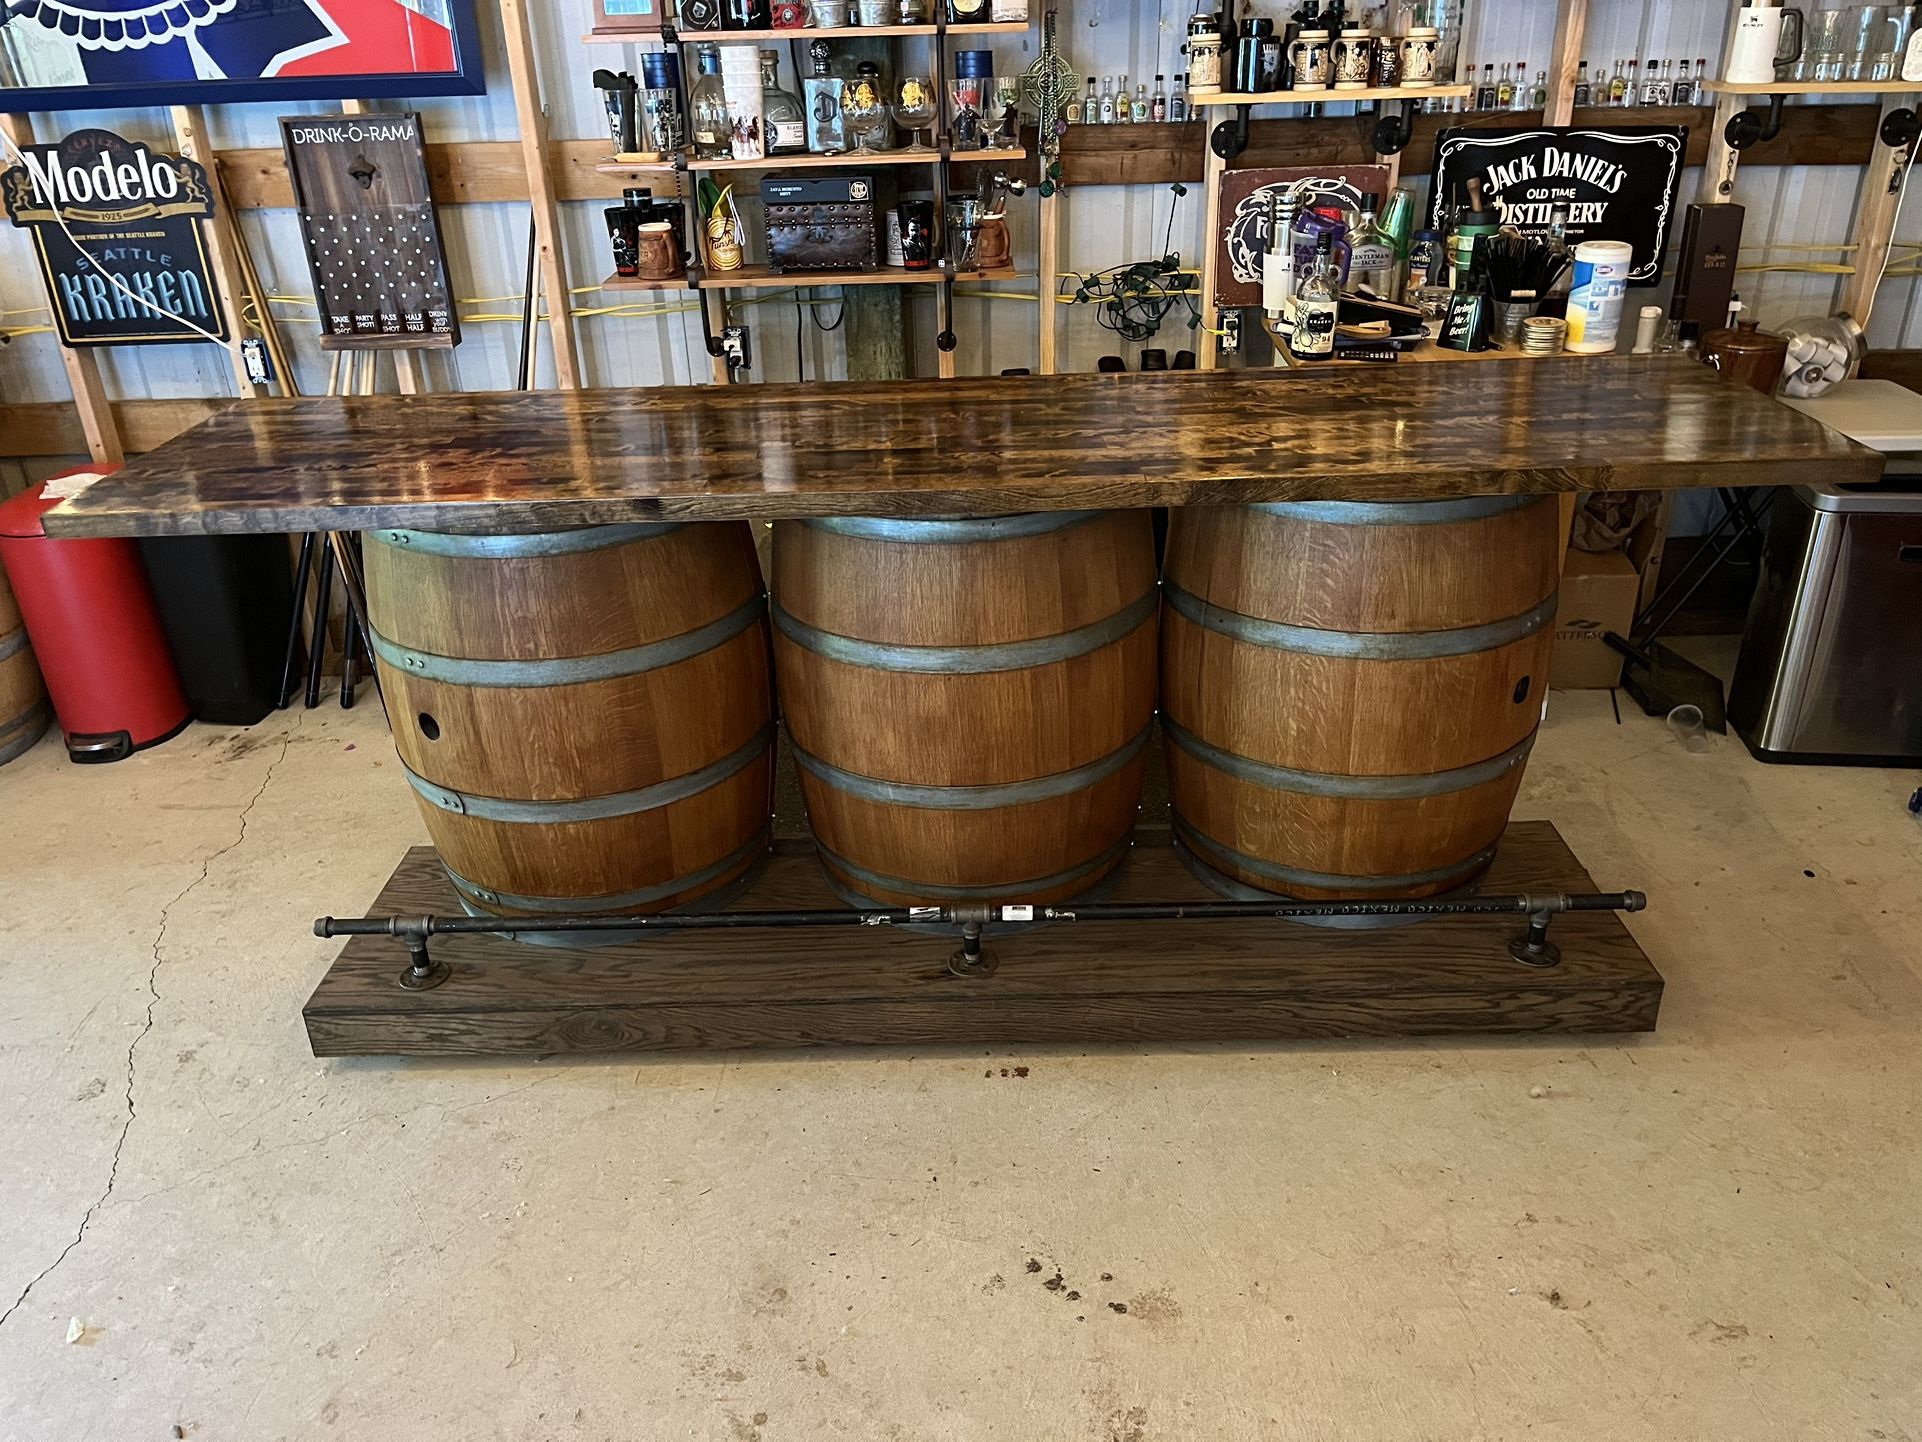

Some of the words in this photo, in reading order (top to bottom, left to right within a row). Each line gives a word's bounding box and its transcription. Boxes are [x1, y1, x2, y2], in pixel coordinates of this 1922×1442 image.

[22, 148, 179, 204] Modelo
[1482, 153, 1539, 196] JACK
[1542, 146, 1628, 195] DANIEL'S
[1526, 188, 1549, 200] OLD
[1551, 188, 1577, 199] TIME
[101, 211, 124, 221] 1925
[1494, 198, 1609, 225] DISTIERY
[76, 247, 172, 271] SEATTLE
[58, 269, 209, 322] KRAKEN
[331, 315, 350, 324] TAKE
[355, 314, 374, 322] PARTY
[381, 313, 398, 322] PASS
[405, 313, 422, 321] HALF
[383, 325, 400, 333] SHOT
